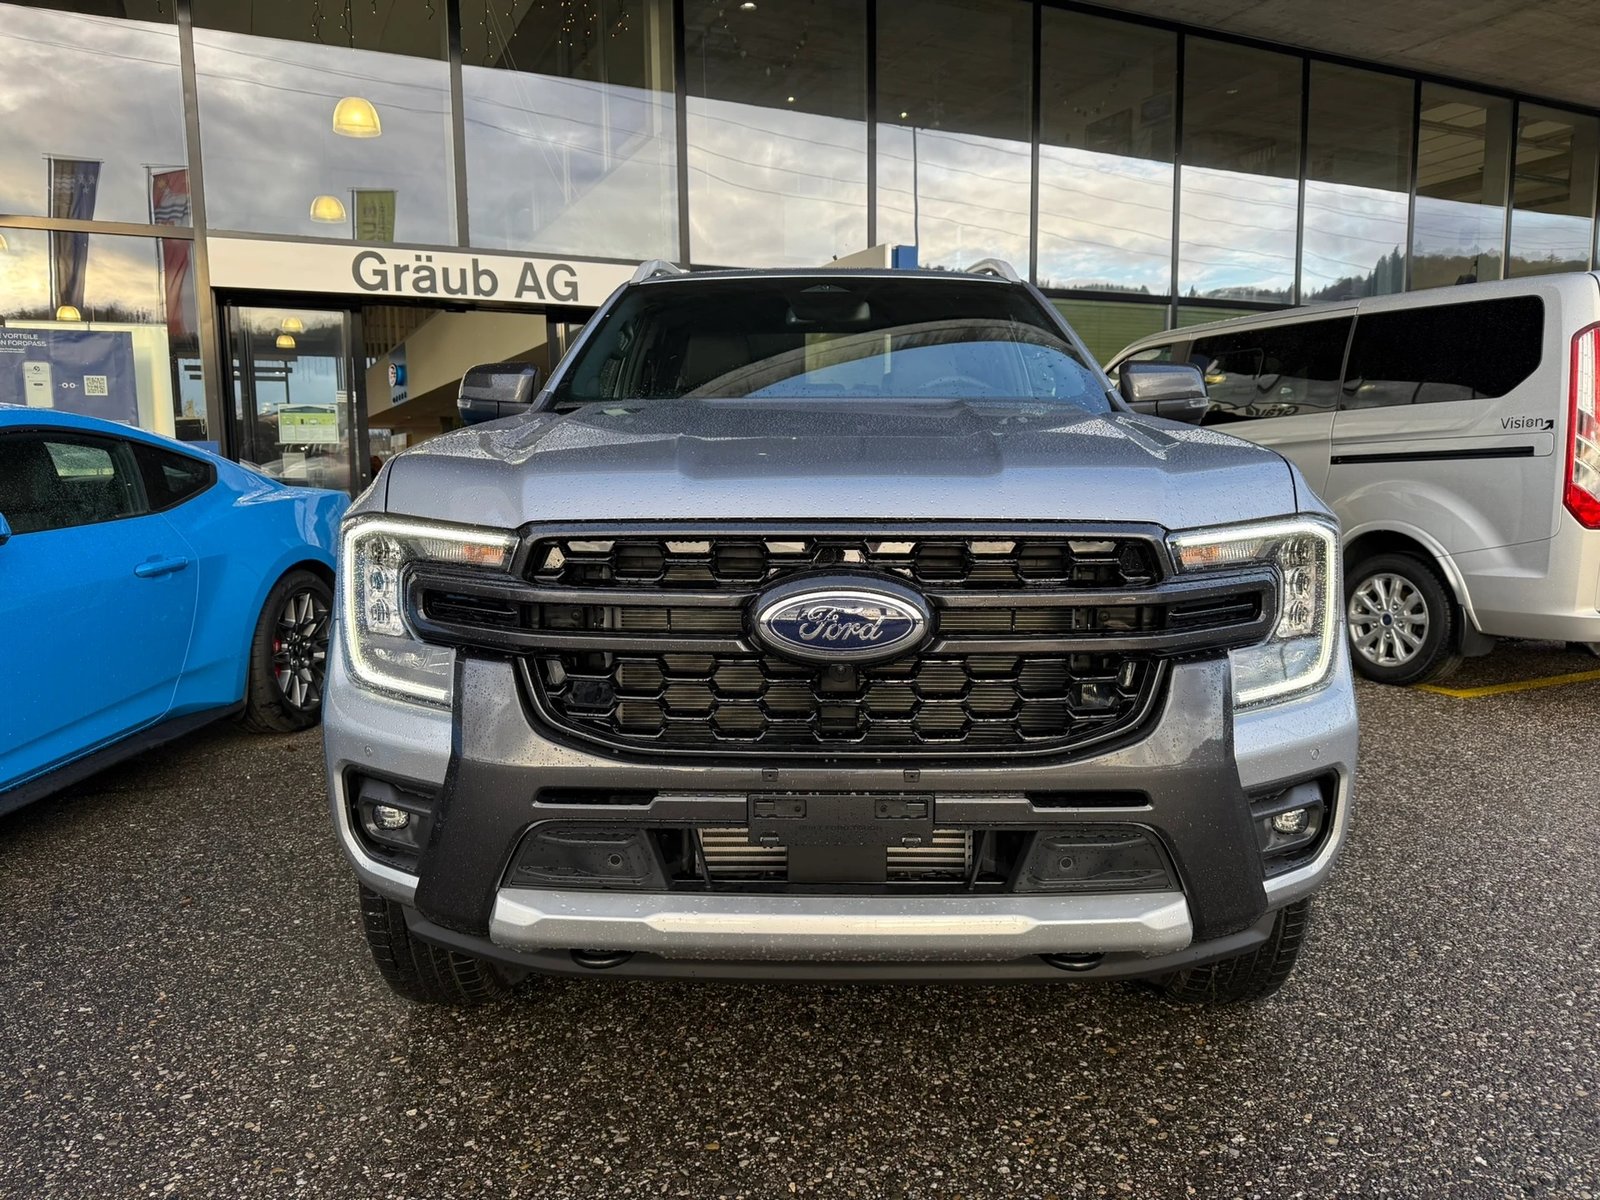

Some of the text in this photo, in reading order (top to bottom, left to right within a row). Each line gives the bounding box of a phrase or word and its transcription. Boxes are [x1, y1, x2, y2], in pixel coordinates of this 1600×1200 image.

[351, 250, 580, 303] Gräub AG
[3, 332, 39, 340] VORTEILE
[8, 339, 47, 347] FORDPASS
[1500, 416, 1544, 430] Vision
[798, 605, 884, 641] Ford
